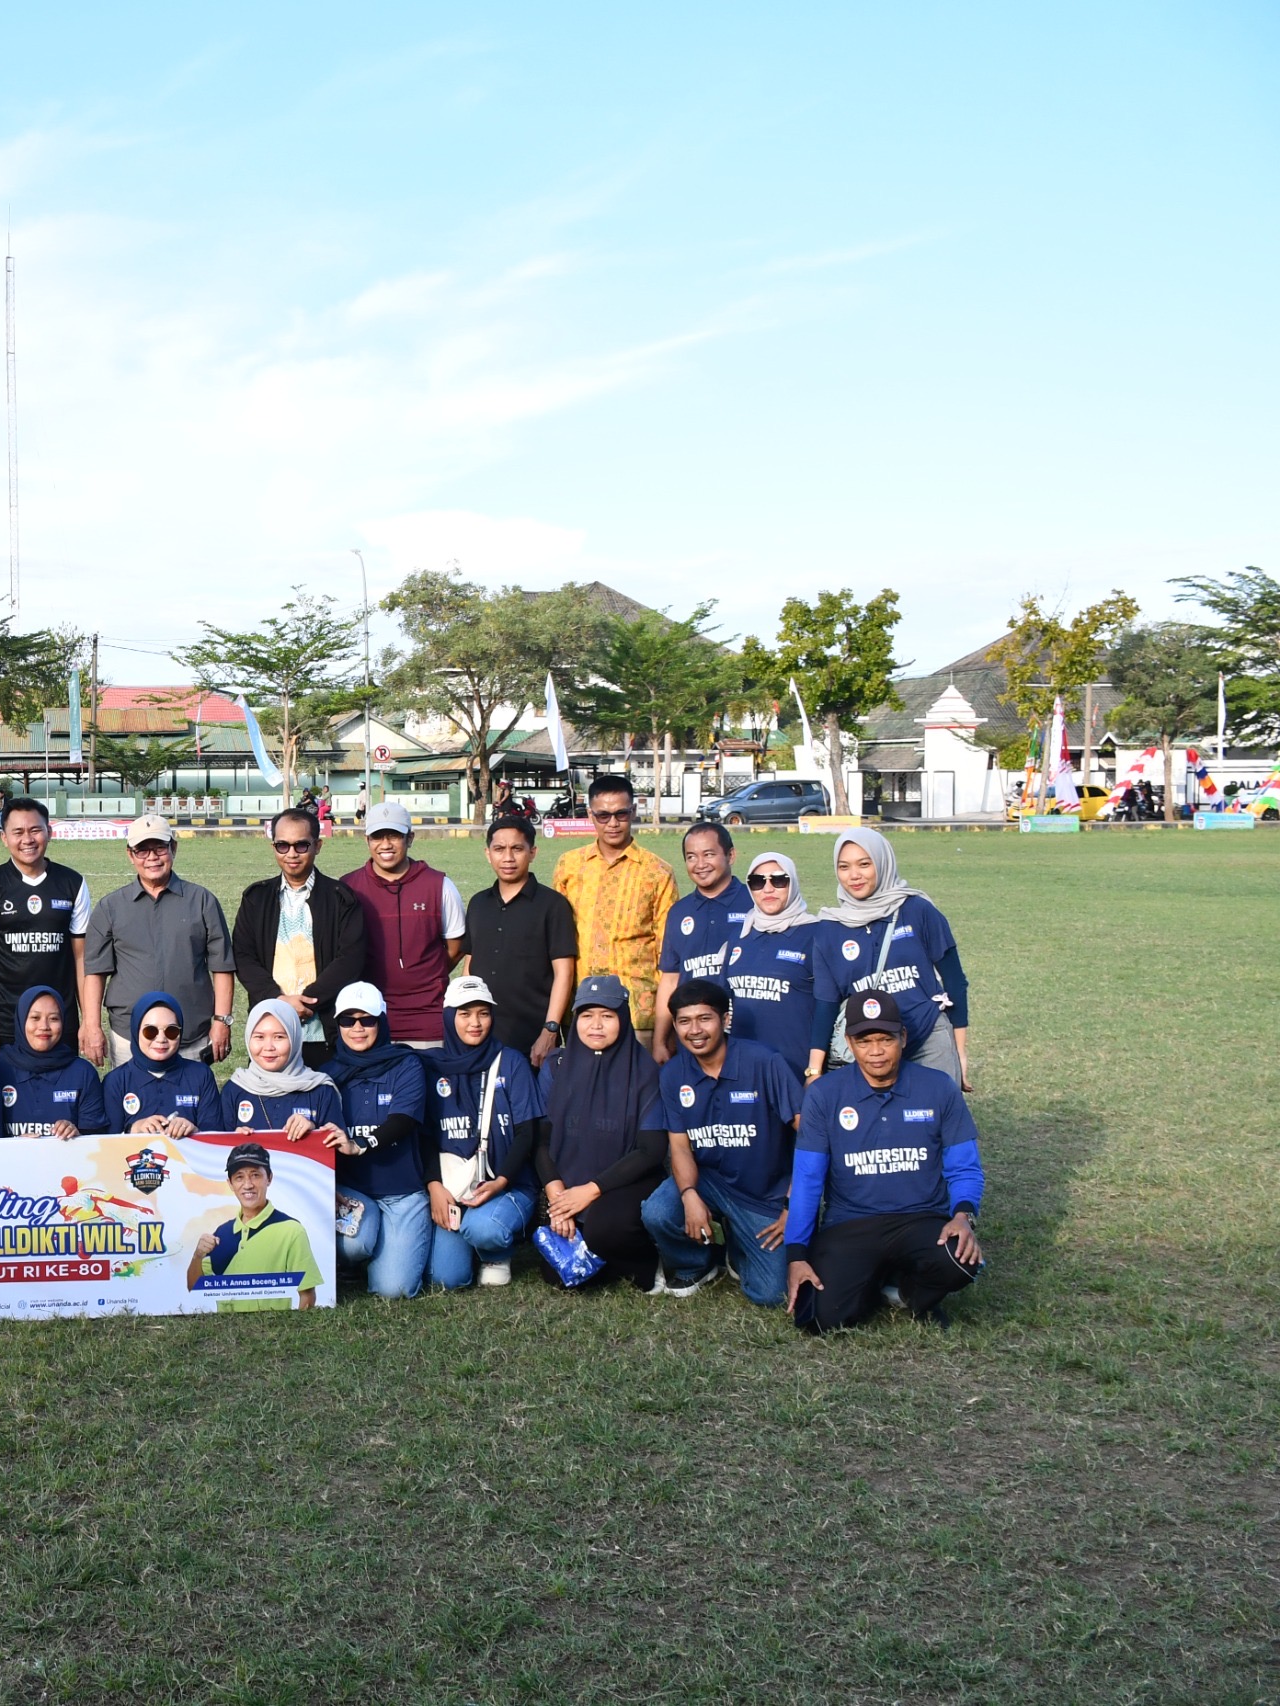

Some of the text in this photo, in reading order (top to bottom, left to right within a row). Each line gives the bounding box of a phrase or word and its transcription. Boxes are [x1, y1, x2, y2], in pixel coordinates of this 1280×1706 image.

[5, 932, 64, 945] UNIVERSITAS
[11, 943, 60, 953] ANDI DJEMMA
[747, 988, 781, 1002] DJEMMA
[448, 1129, 468, 1140] ANDI
[696, 1136, 717, 1149] ANDI
[844, 1147, 927, 1167] UNIVERSITAS
[854, 1160, 920, 1176] ANDI DJEMMA
[81, 1221, 135, 1255] WIL.
[138, 1221, 165, 1255] IX
[23, 1264, 40, 1279] RI
[45, 1262, 103, 1277] KE-80
[29, 1300, 89, 1309] www.unanda.ac.id
